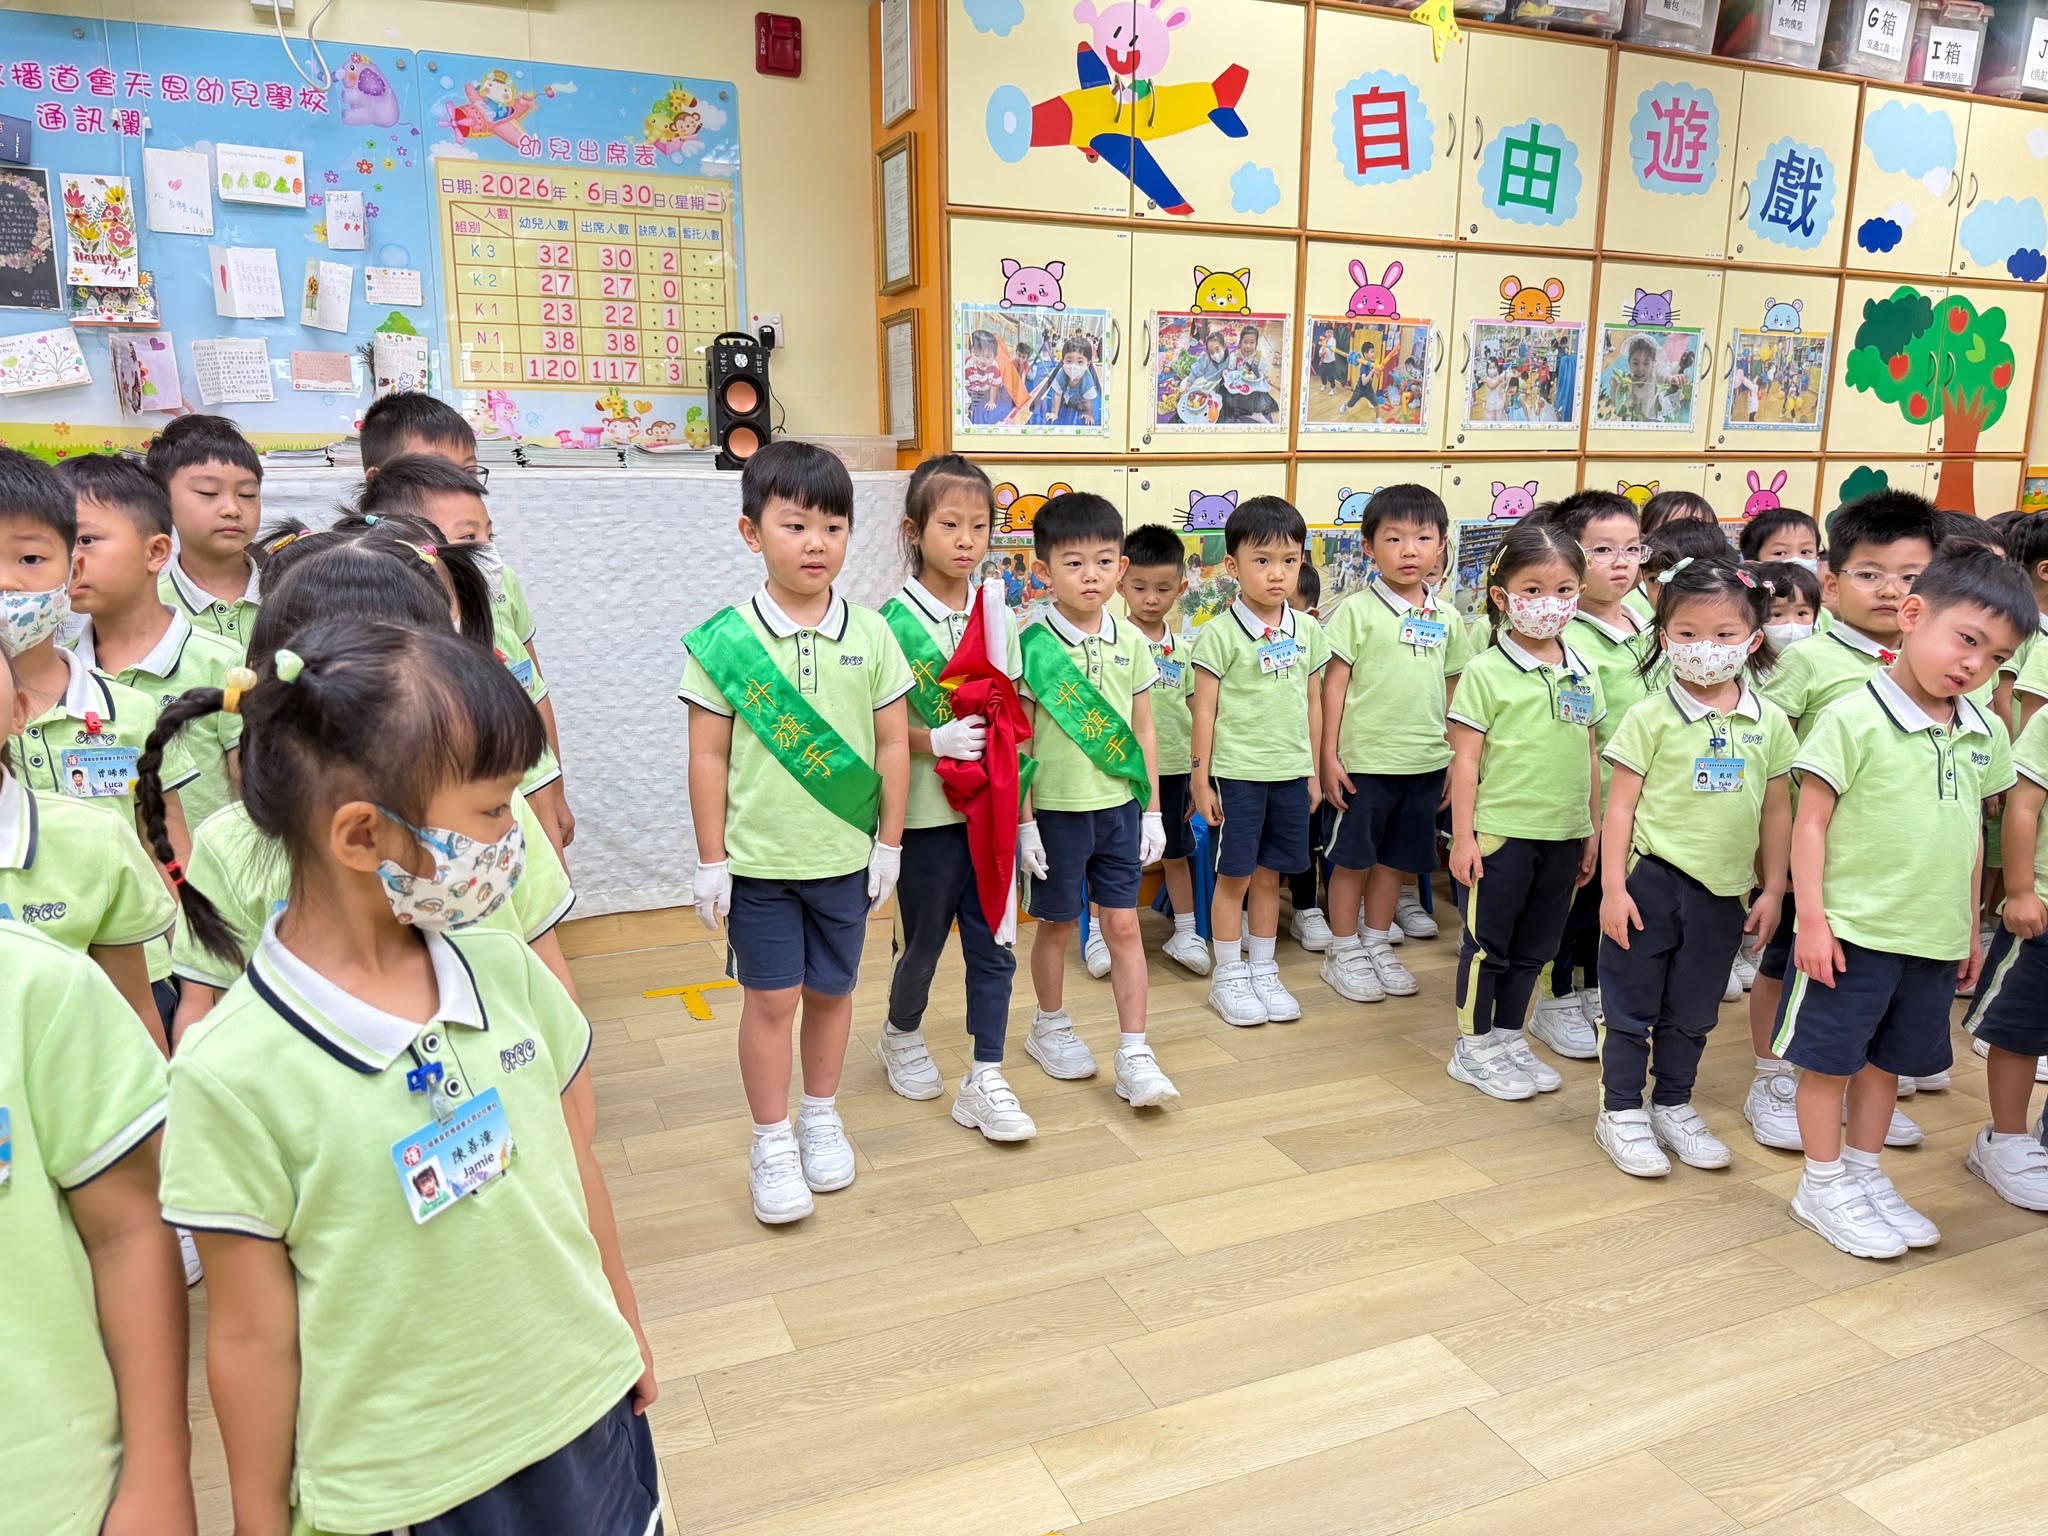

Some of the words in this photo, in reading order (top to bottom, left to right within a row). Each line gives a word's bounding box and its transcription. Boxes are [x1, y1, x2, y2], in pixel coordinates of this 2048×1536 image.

[1867, 7, 1880, 28] G
[1880, 11, 1898, 37] 箱
[1931, 41, 1942, 60] I
[1943, 42, 1962, 65] 箱
[0, 63, 328, 114] 播道會天恩幼兒學校
[36, 103, 141, 136] 通訊欄
[519, 134, 656, 167] 幼兒出席表
[485, 207, 509, 220] 人數
[455, 220, 481, 233] 組別
[519, 216, 569, 232] 幼兒人數
[581, 220, 630, 236] 出席人數
[638, 224, 676, 239] 缺席人數
[73, 252, 120, 268] Happy
[540, 245, 570, 264] 32
[601, 248, 633, 267] 30
[663, 252, 675, 270] 2
[101, 266, 132, 280] day!
[541, 273, 571, 292] 27
[603, 276, 633, 295] 27
[663, 279, 677, 298] 0
[543, 302, 574, 321] 23
[605, 305, 634, 324] 22
[667, 308, 676, 326] 1
[545, 331, 576, 350] 38
[607, 332, 636, 352] 38
[666, 335, 679, 354] 0
[530, 359, 577, 378] 120
[592, 361, 637, 380] 117
[669, 363, 681, 381] 3
[463, 1153, 495, 1179] Jamie
